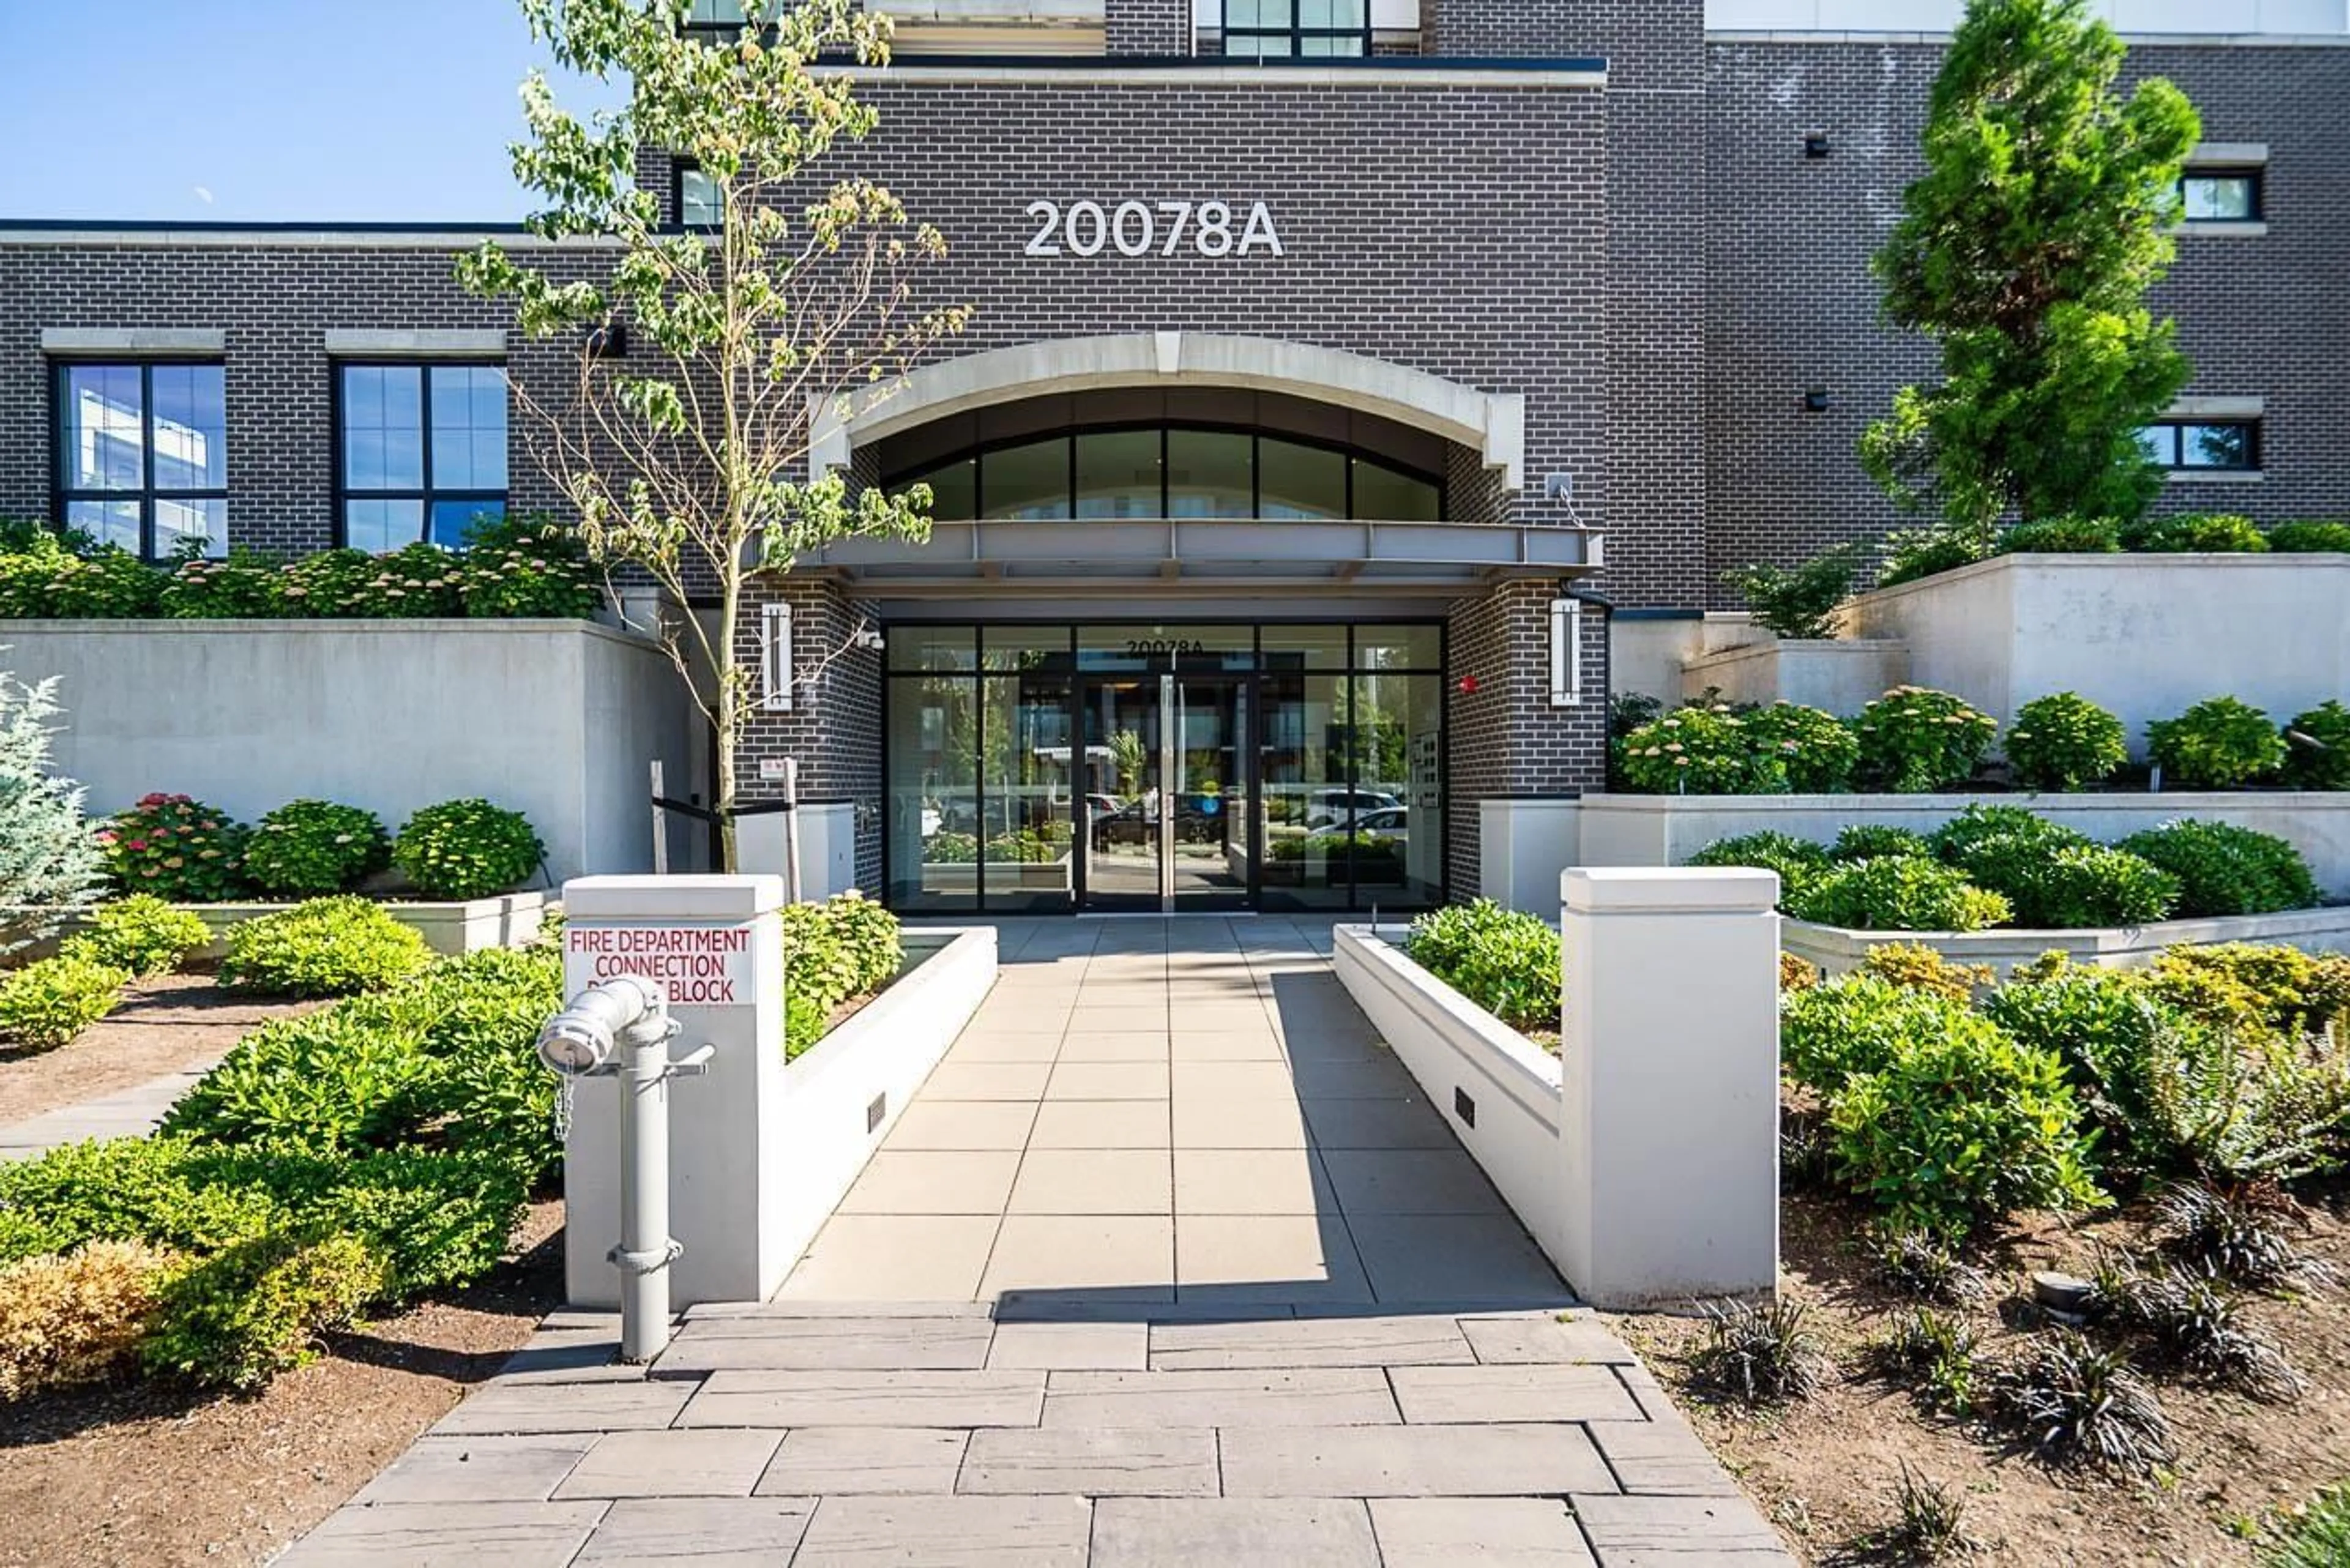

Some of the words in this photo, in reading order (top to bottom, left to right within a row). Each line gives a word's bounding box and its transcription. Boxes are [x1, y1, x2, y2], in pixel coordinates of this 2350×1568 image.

[1024, 201, 1283, 256] 20078A
[570, 930, 613, 952] FIRE
[619, 930, 750, 952] DEPARTMENT
[595, 955, 725, 977] CONNECTION
[668, 980, 734, 1002] BLOCK
